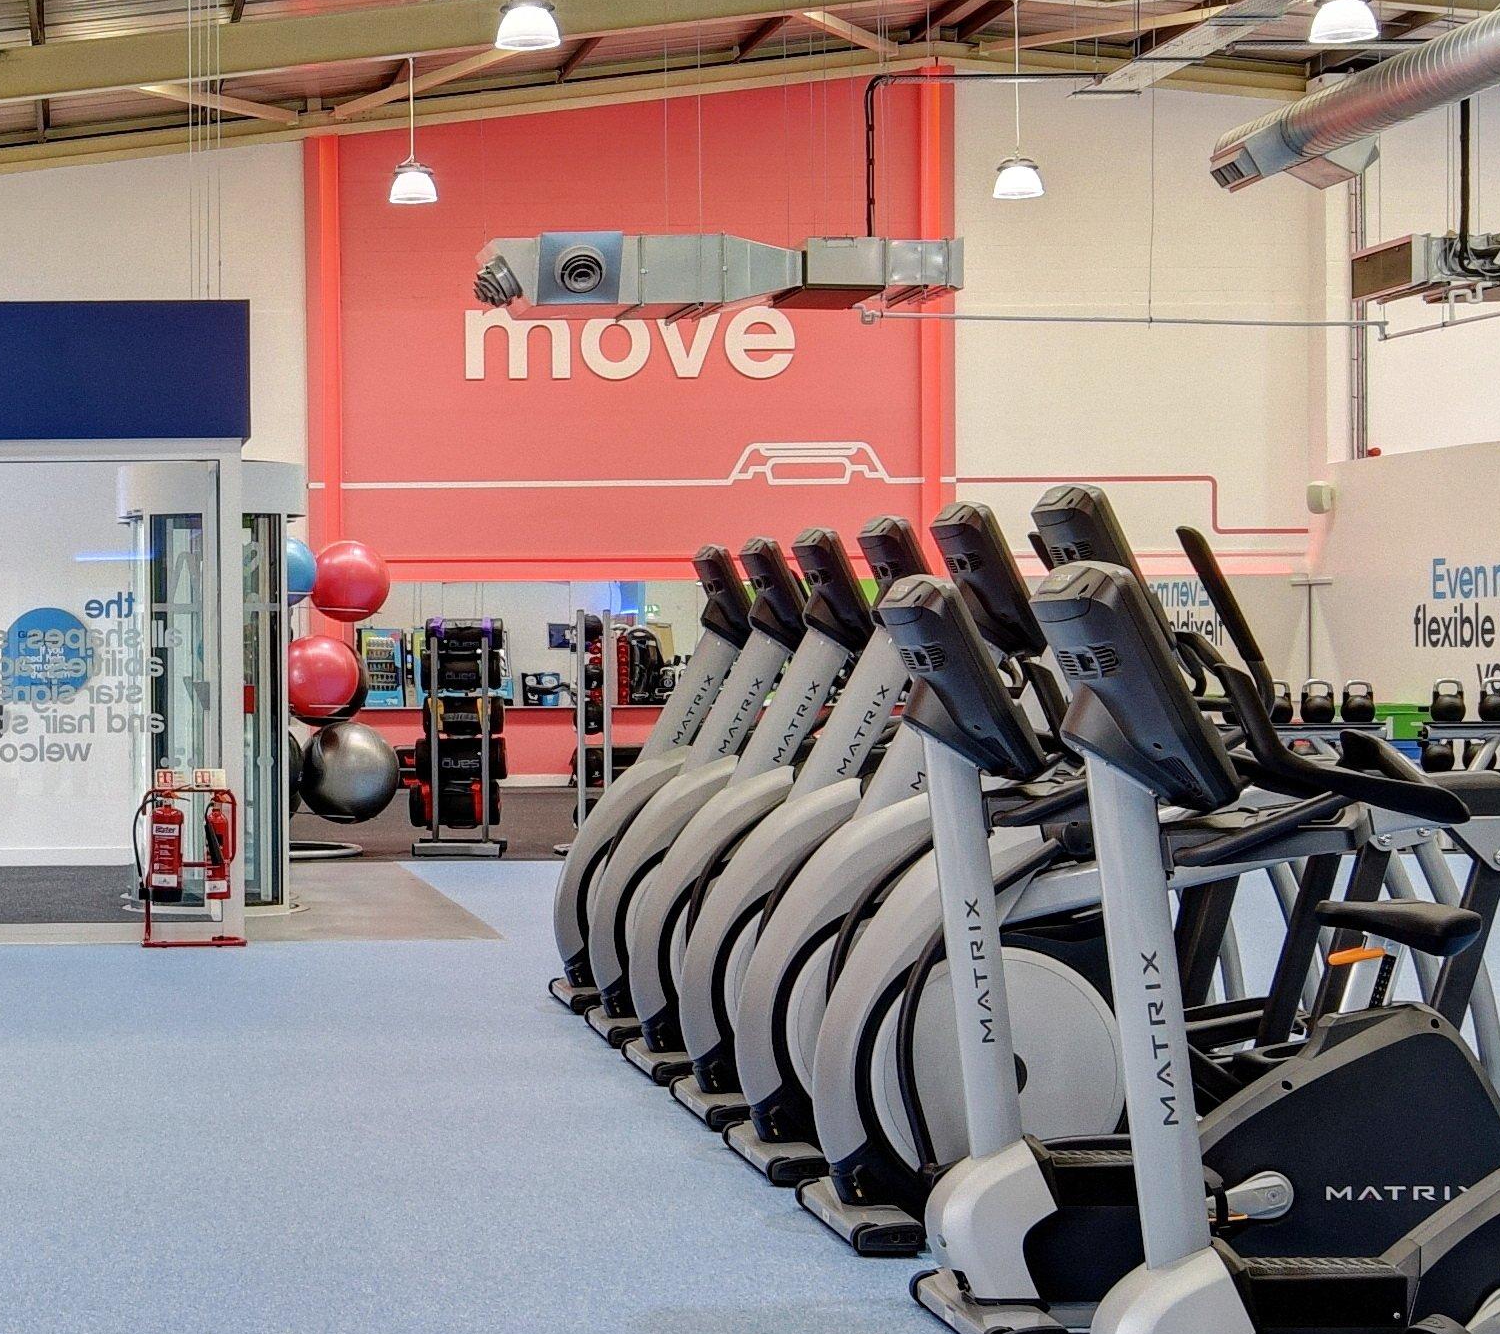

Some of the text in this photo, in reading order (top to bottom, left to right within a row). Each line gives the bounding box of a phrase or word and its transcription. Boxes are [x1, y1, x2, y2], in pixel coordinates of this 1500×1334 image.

[463, 307, 797, 382] move
[1432, 558, 1488, 600] Even
[1414, 601, 1495, 649] flexible
[671, 674, 714, 745] MATRIX
[717, 677, 764, 754] MATRIX
[772, 680, 821, 763] MATRIX
[836, 684, 890, 775] MATRIX
[965, 897, 996, 1045] MATRIX
[1139, 949, 1179, 1127] MATRIX
